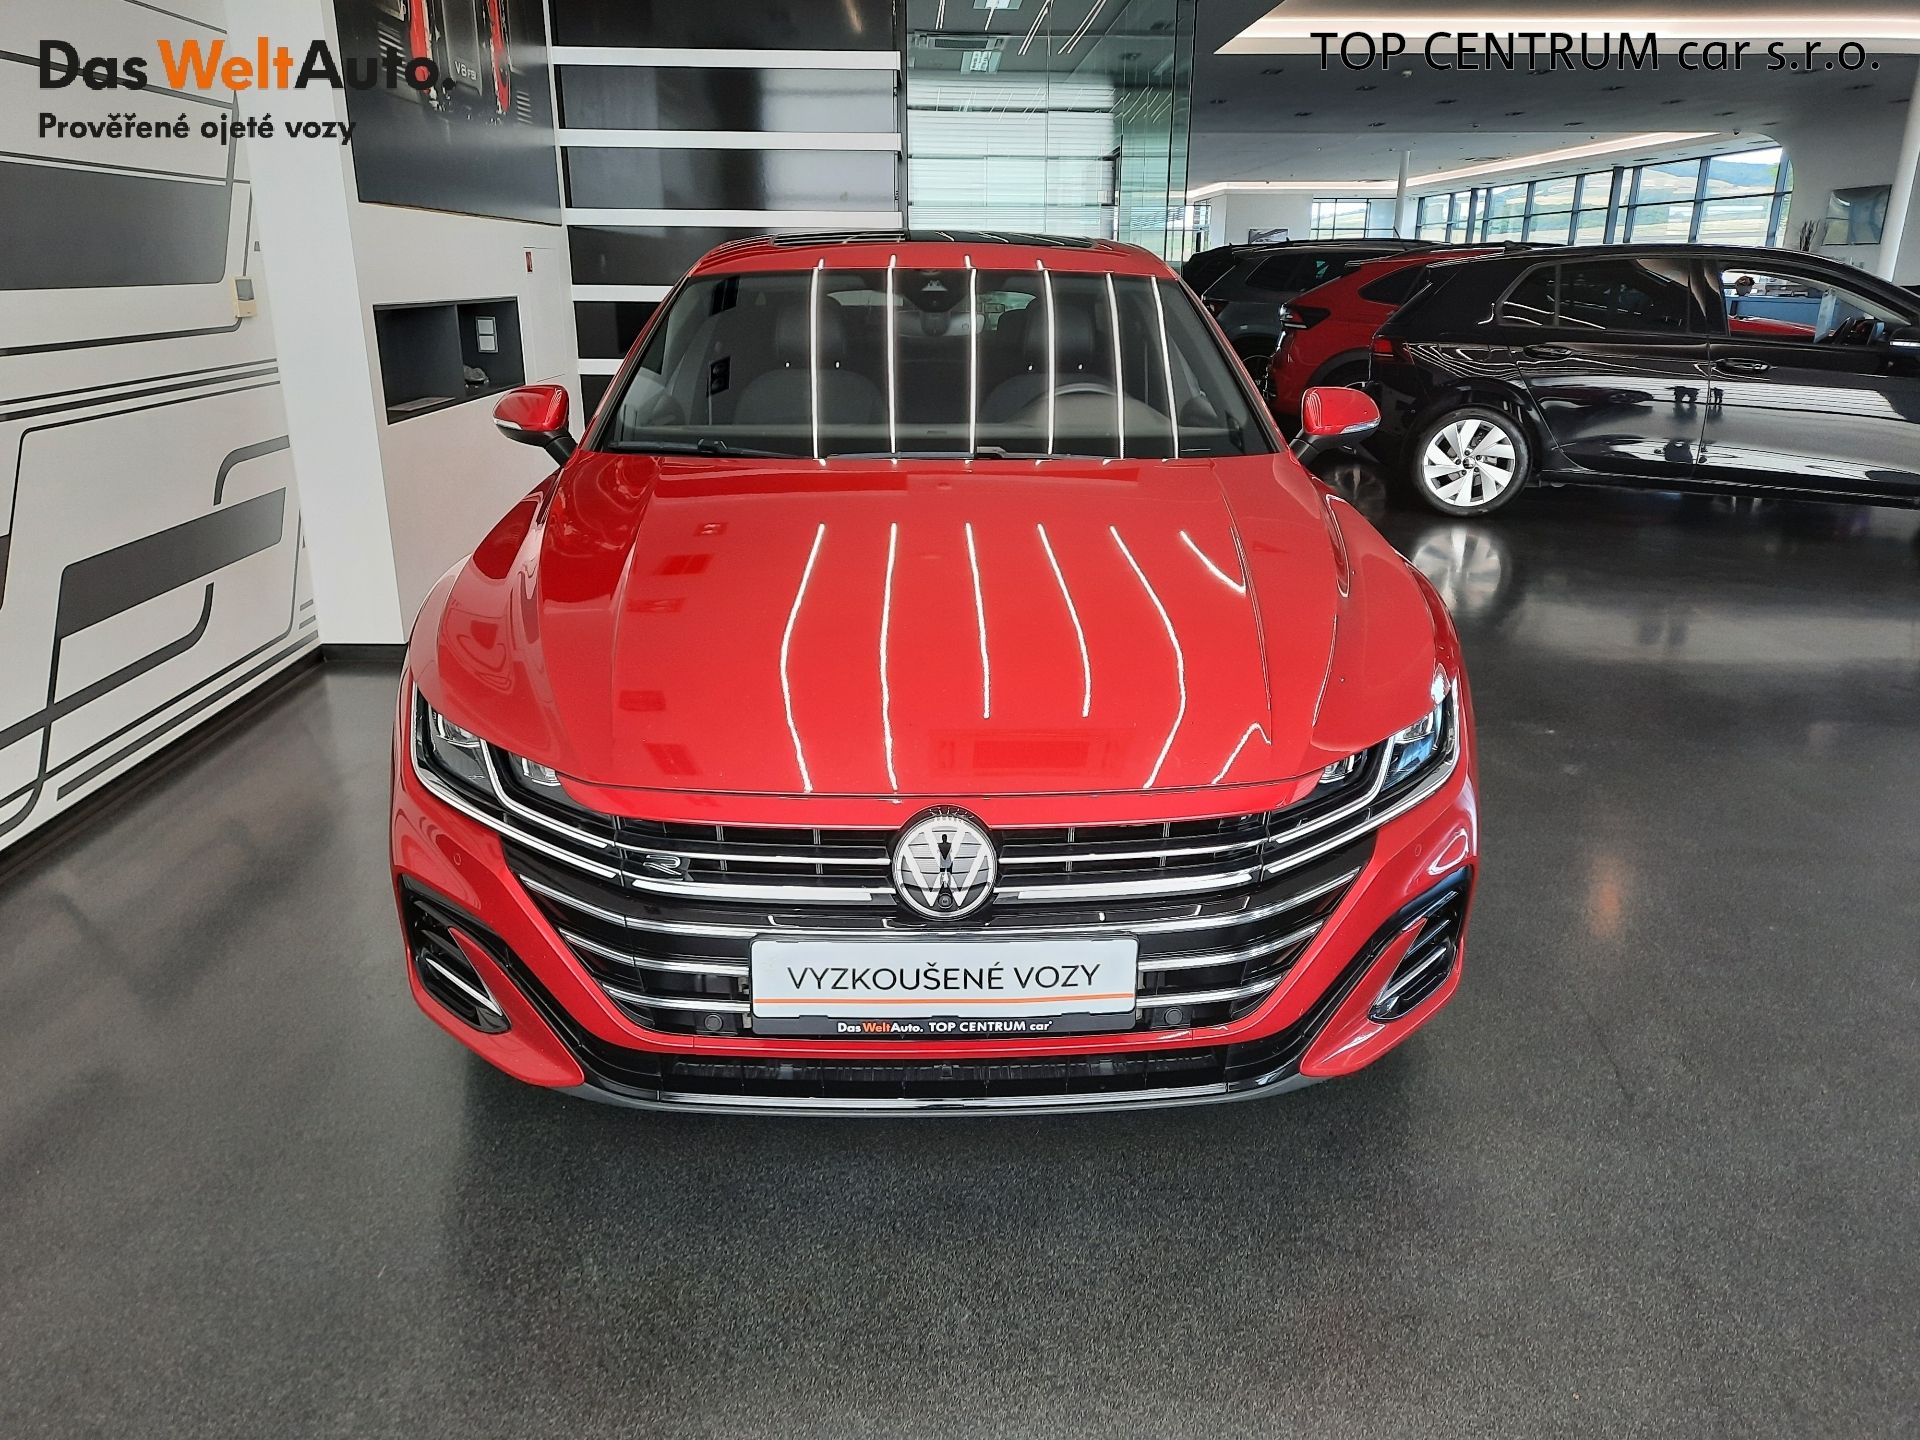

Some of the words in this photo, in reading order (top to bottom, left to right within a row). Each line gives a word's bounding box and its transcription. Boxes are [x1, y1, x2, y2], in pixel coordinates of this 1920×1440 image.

[787, 961, 1004, 991] VYZKOUŠENÉ
[1014, 963, 1101, 990] VOZY
[929, 1022, 956, 1033] TOP
[959, 1020, 1026, 1032] CENTRUM
